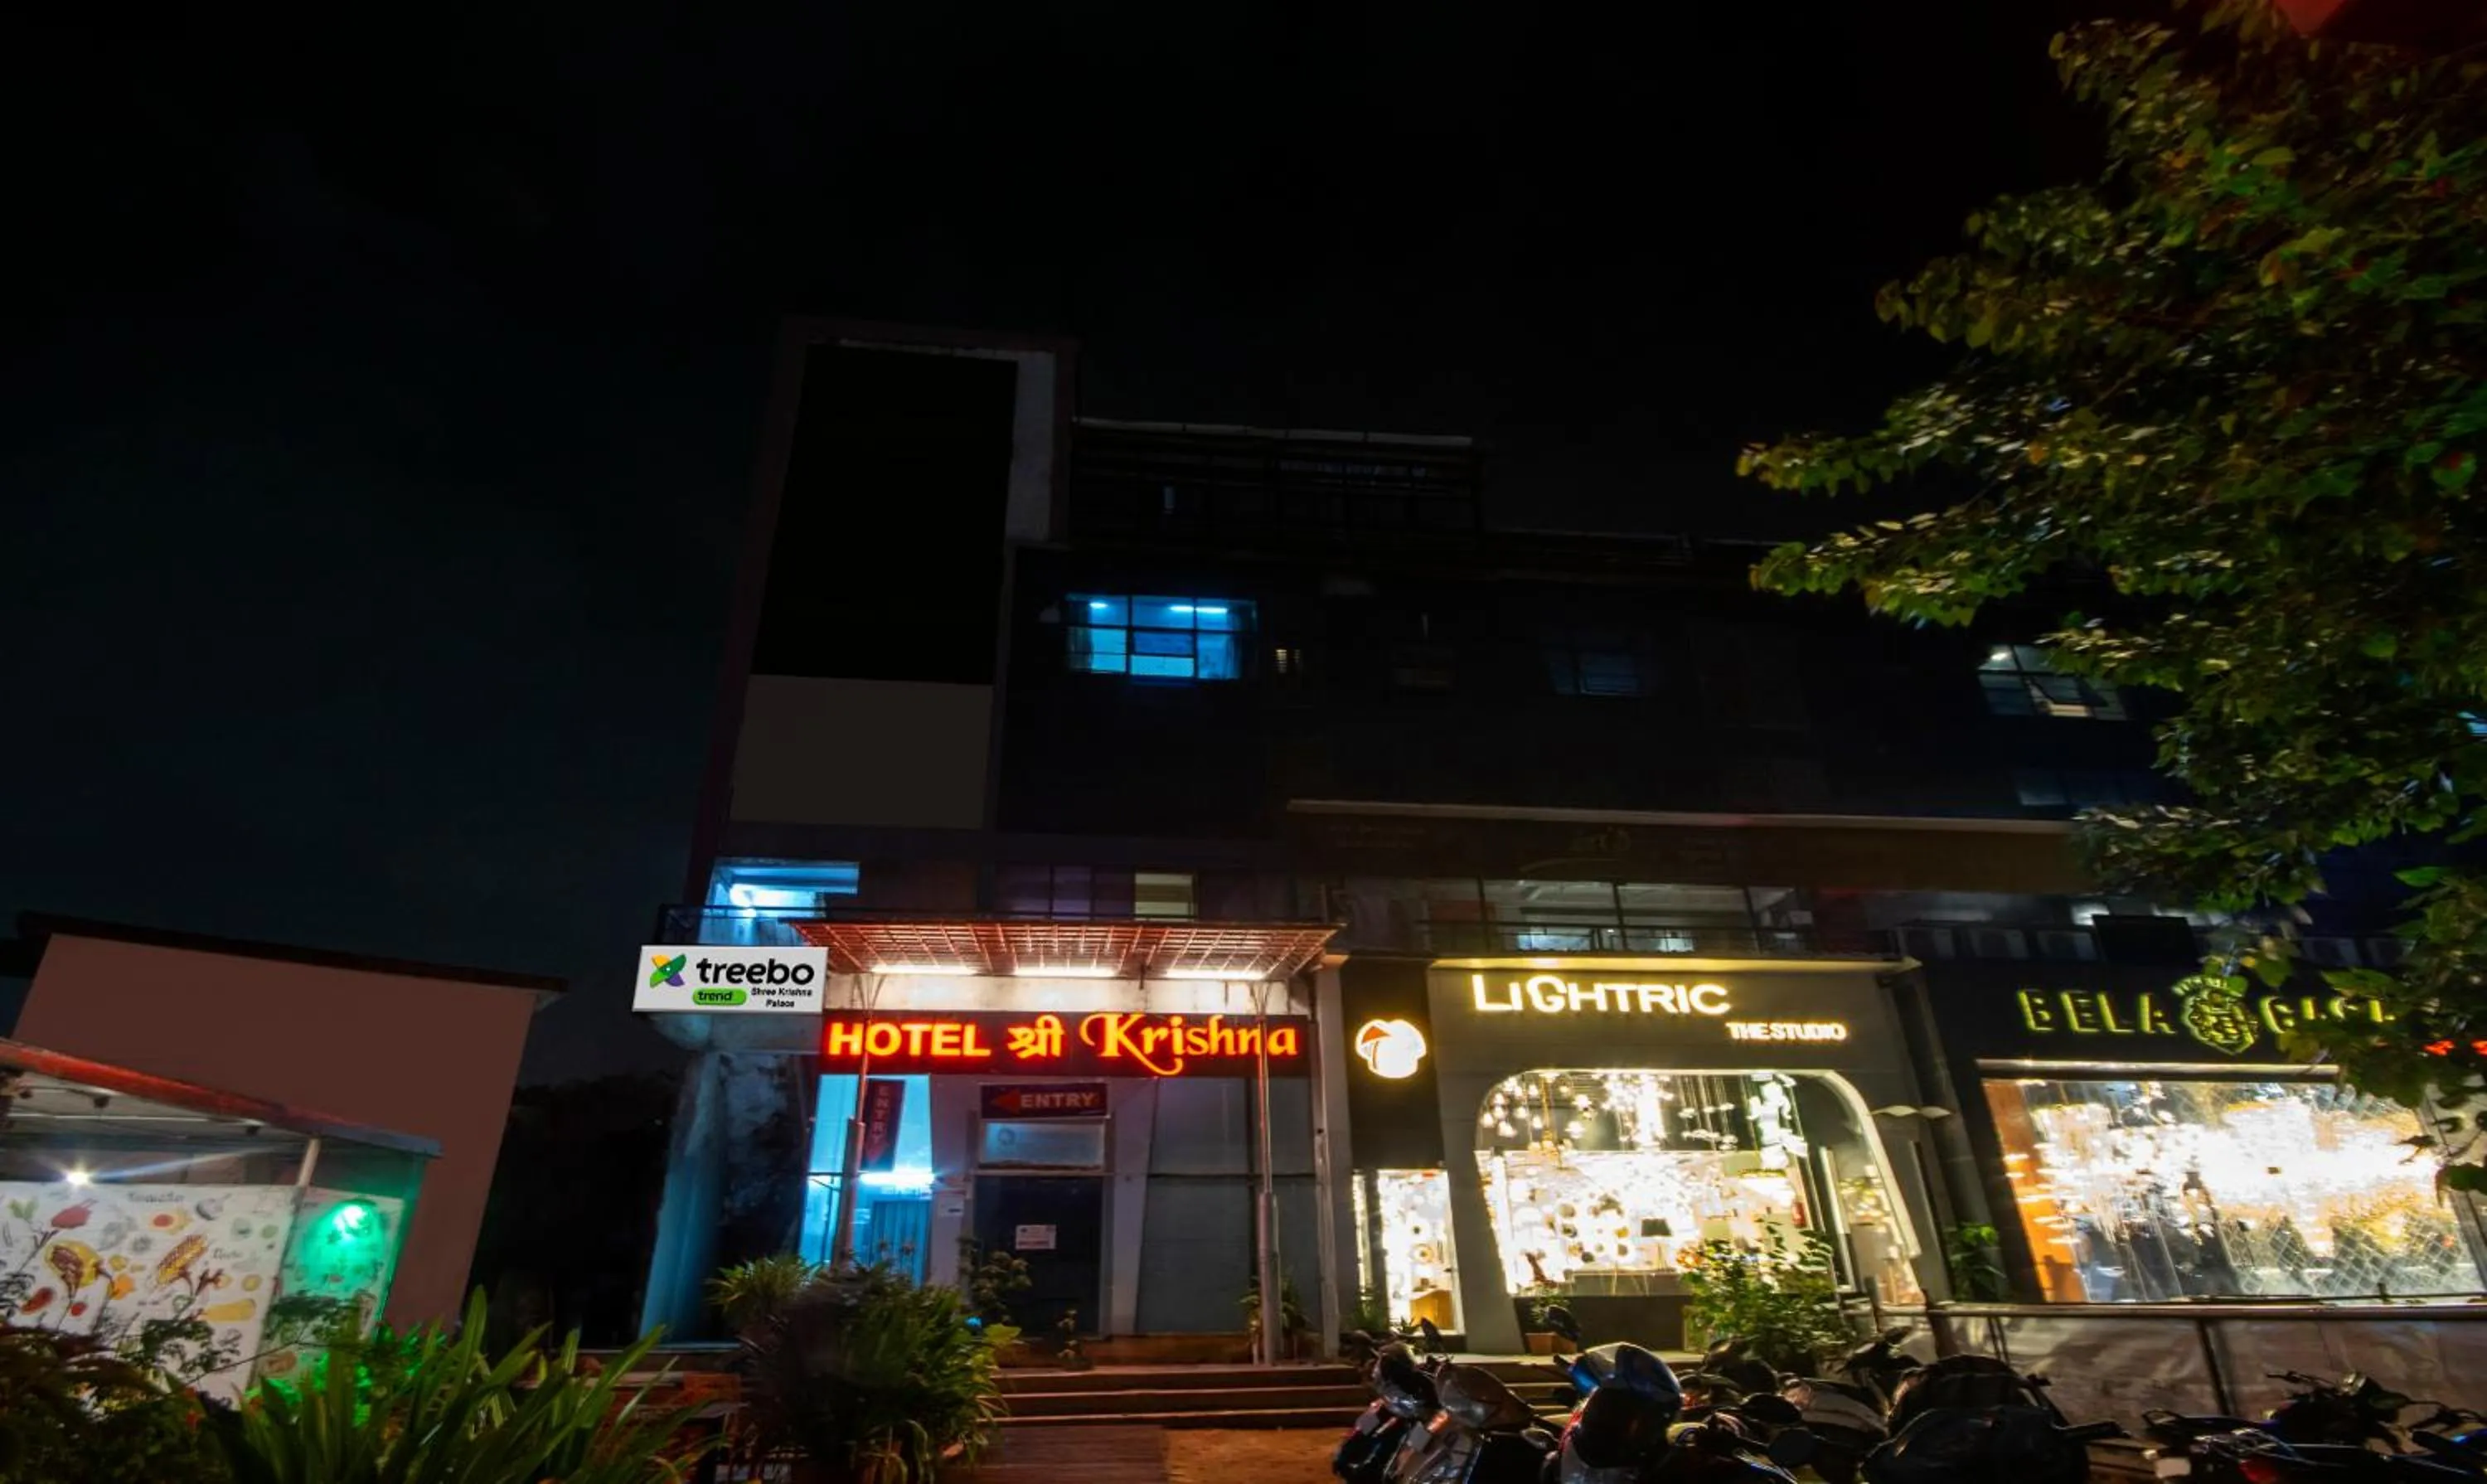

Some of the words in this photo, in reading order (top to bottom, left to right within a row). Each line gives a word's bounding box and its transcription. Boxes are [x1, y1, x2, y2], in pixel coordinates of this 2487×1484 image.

[696, 958, 815, 986] treebo
[698, 991, 734, 1001] trend
[1726, 1021, 1770, 1040] THE
[1770, 1022, 1847, 1041] STUDIO
[829, 1021, 991, 1057] HOTEL
[1007, 1014, 1064, 1059] श्री
[1080, 1011, 1298, 1075] Krishna
[1020, 1092, 1097, 1108] ENTRY
